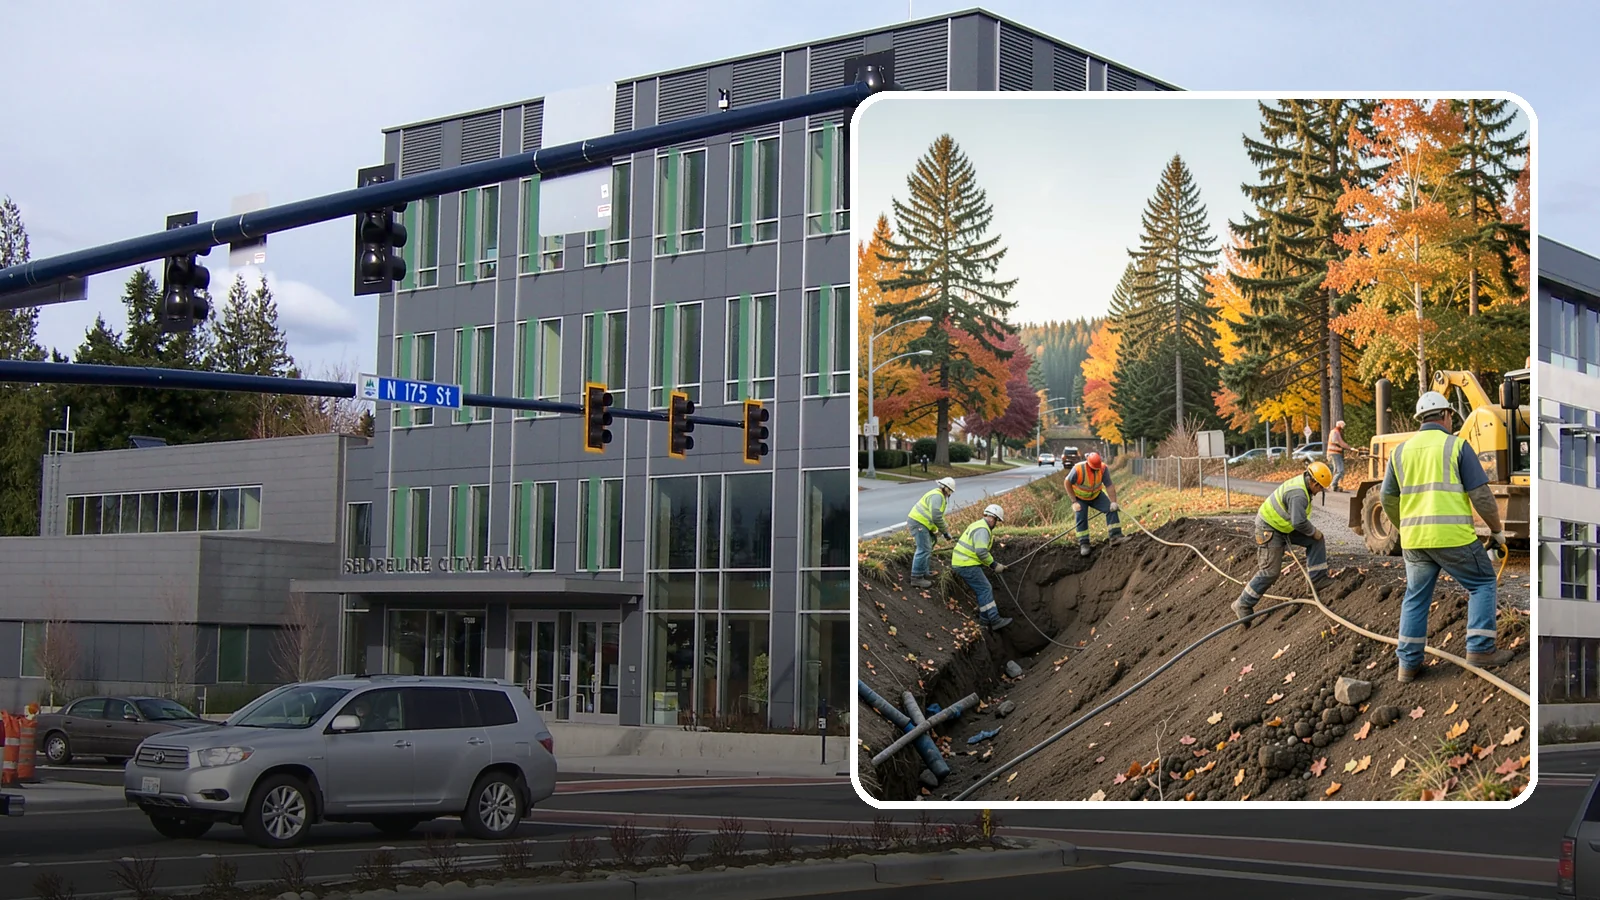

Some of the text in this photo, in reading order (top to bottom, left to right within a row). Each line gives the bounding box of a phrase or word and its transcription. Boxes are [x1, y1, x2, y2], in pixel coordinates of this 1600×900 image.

[387, 381, 452, 406] N 175 St
[344, 555, 525, 574] SHORELINE CITY HALL
